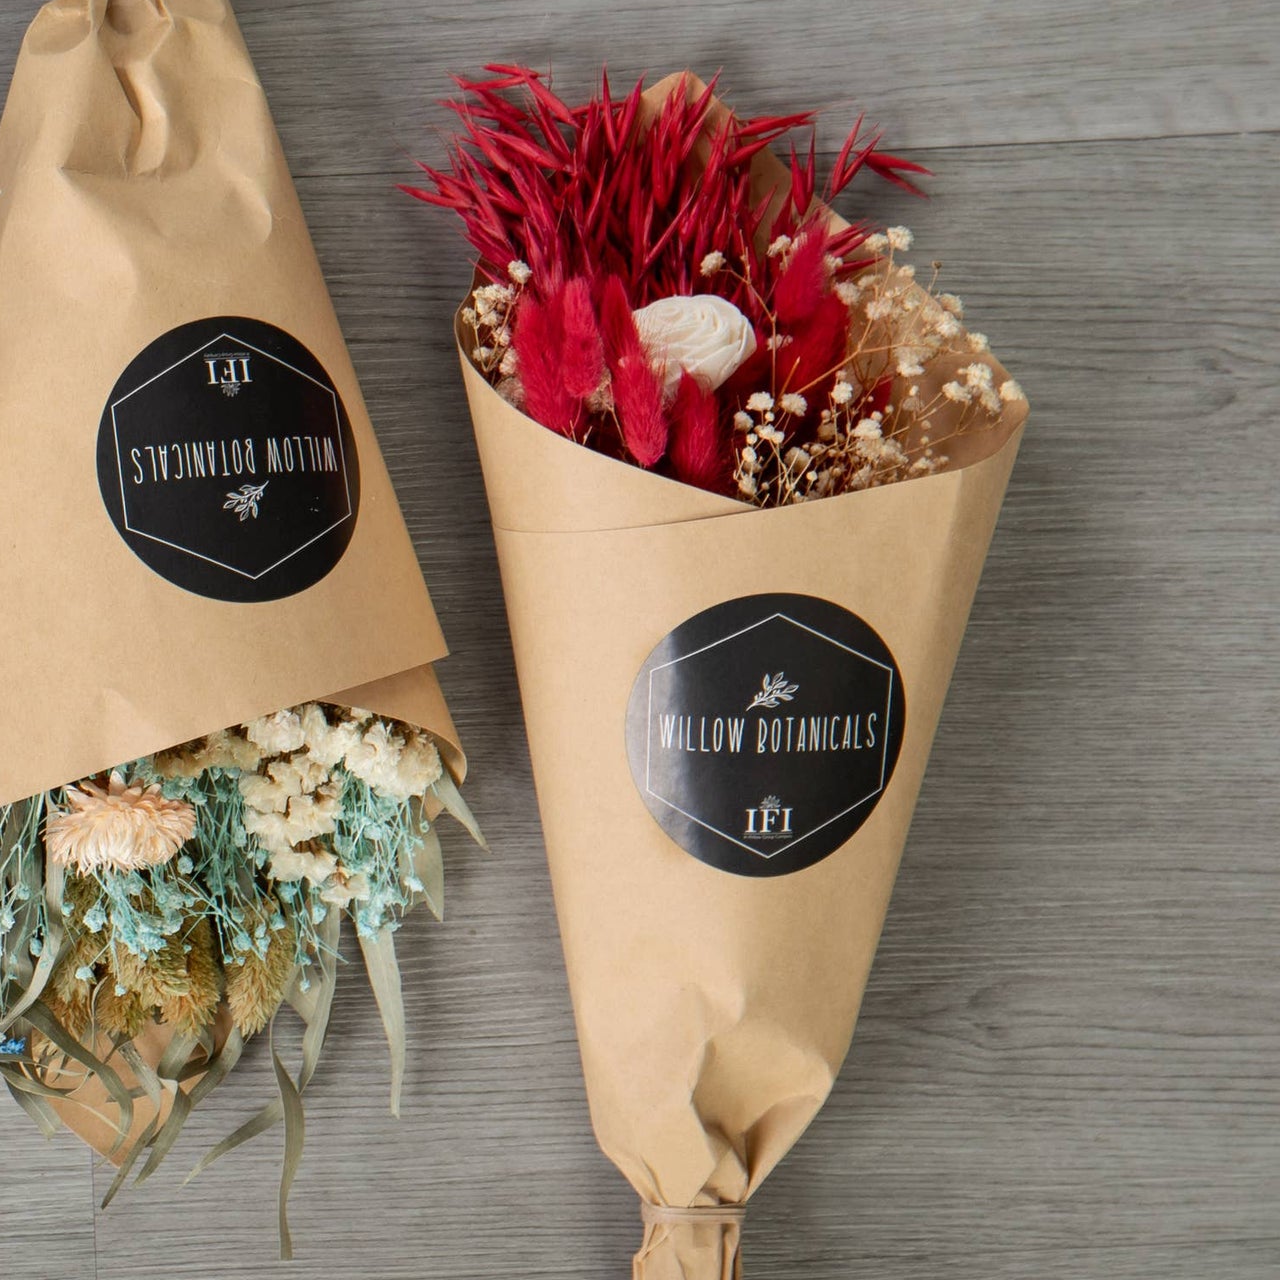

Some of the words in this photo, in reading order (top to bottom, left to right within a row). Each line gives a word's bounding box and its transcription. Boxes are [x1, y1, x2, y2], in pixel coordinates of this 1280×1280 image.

[205, 358, 253, 384] IFI
[131, 438, 256, 484] BOTANICALS
[267, 436, 338, 472] WILLOW
[659, 713, 745, 753] WILLOW
[756, 712, 877, 754] BOTANICALS
[745, 807, 793, 833] IFI
